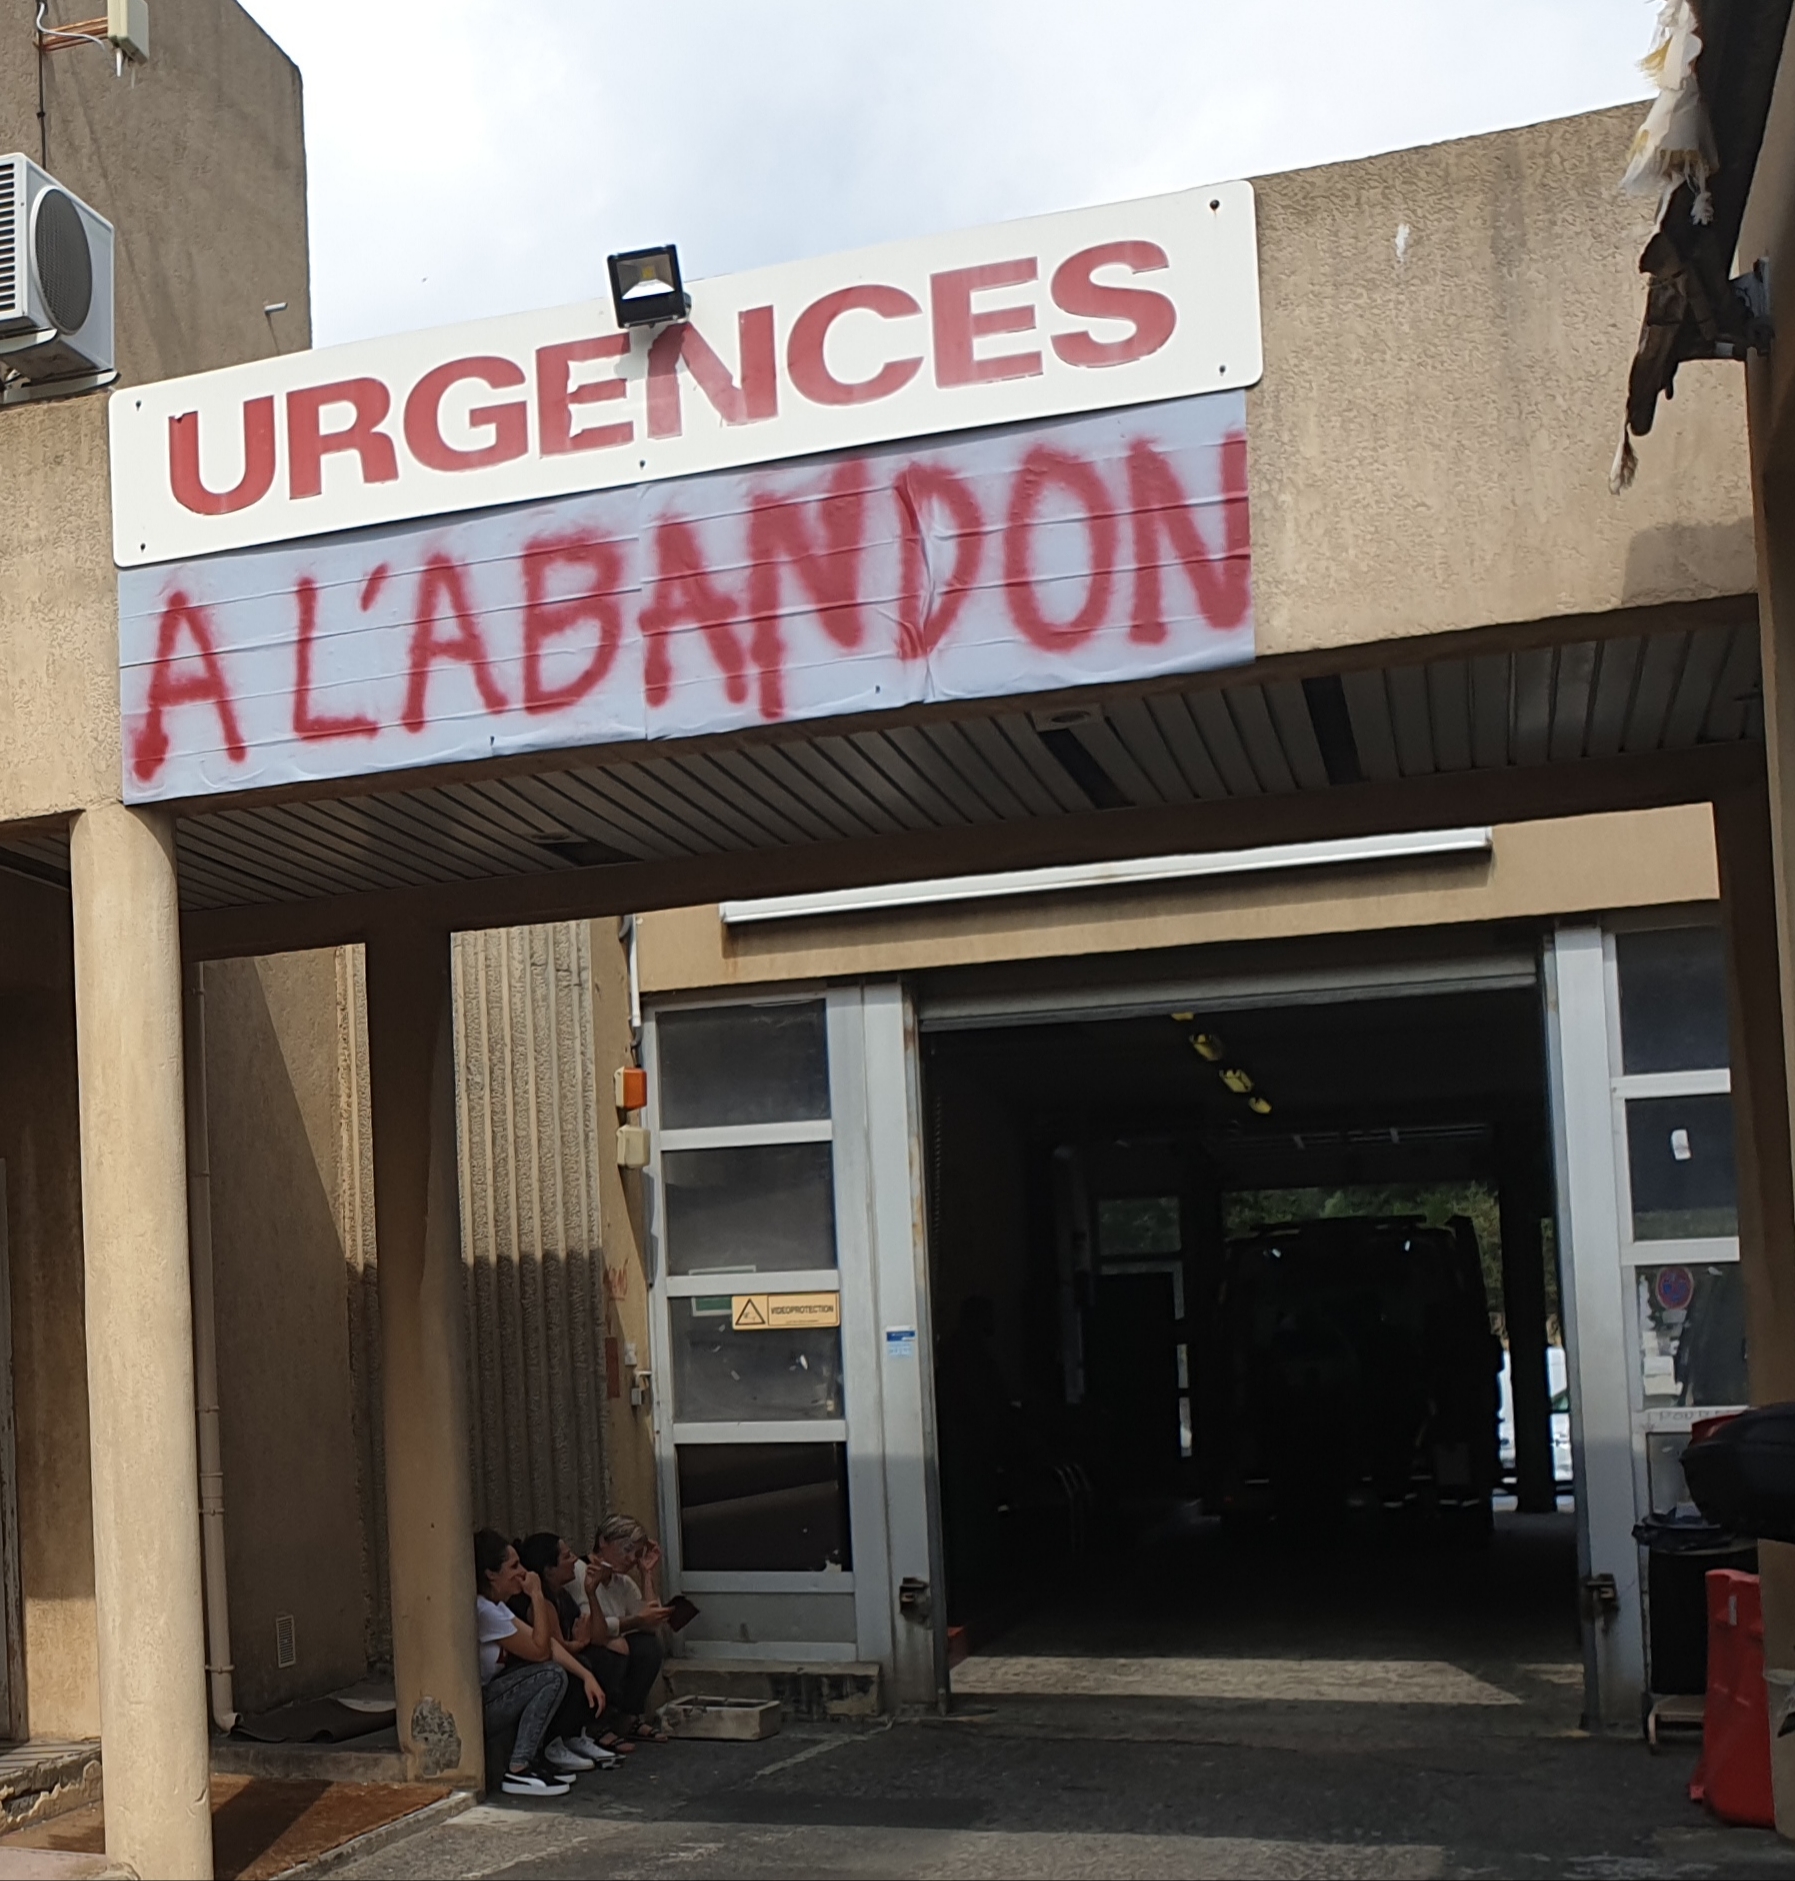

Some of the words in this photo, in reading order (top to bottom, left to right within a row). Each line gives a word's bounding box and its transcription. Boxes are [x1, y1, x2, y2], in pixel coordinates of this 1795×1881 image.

[168, 240, 1177, 515] URGENCES
[130, 588, 248, 784] A
[291, 432, 1253, 744] L'ABANDON
